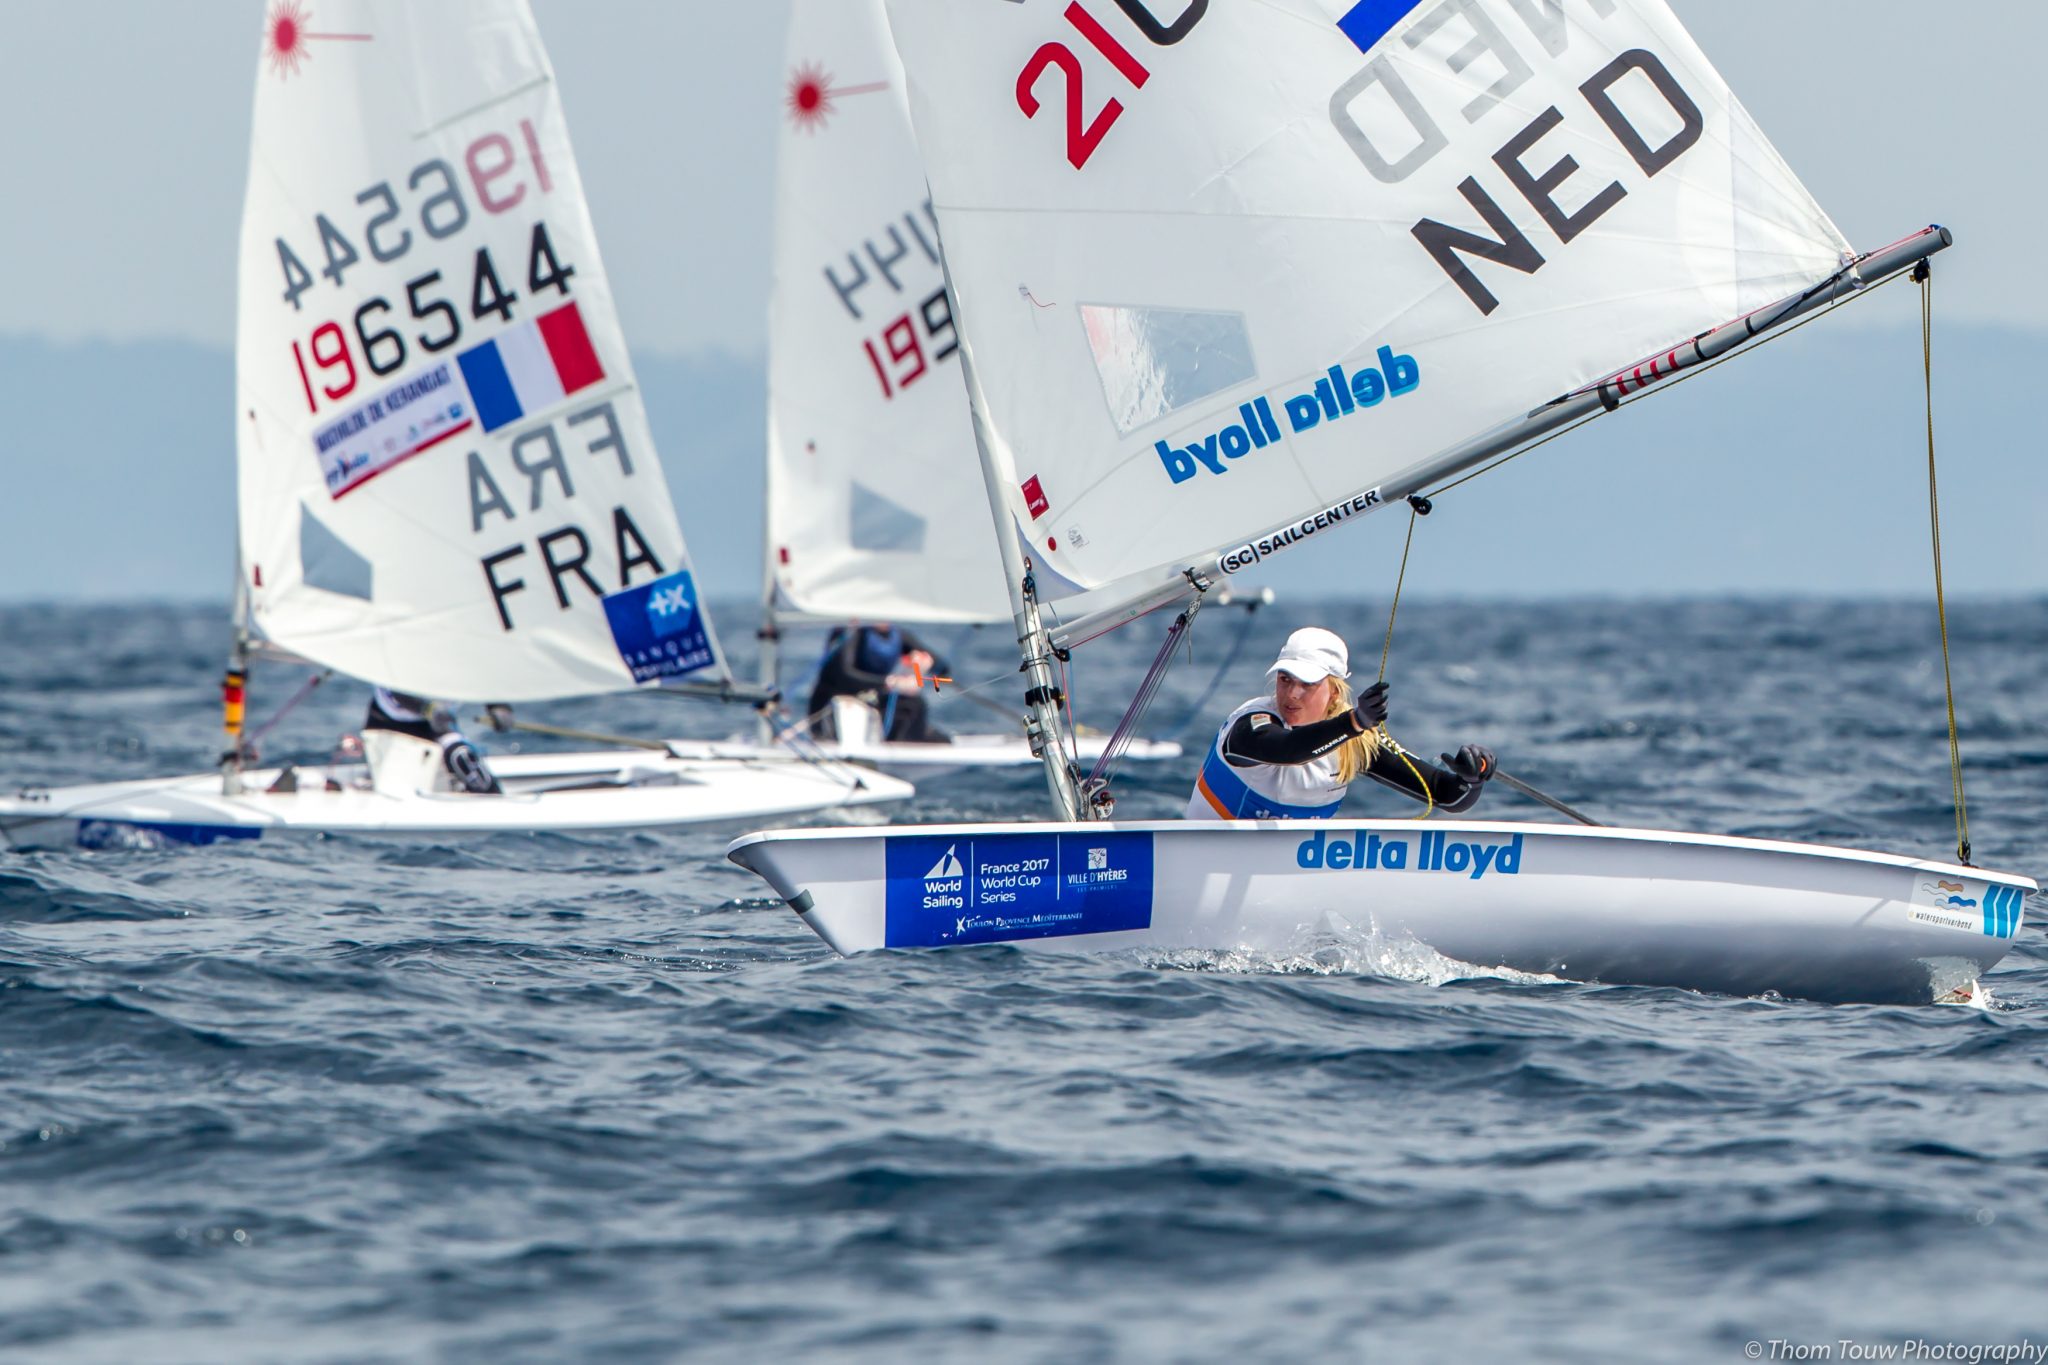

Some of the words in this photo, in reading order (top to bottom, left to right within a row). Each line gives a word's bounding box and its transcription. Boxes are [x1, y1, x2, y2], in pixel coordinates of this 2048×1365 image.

[1411, 48, 1703, 316] NED
[291, 222, 576, 414] 196544
[481, 506, 664, 632] FRA
[1312, 734, 1348, 755] TITANIUM
[1296, 830, 1408, 869] delta
[1418, 830, 1523, 880] lloyd
[981, 862, 1020, 875] France
[1022, 859, 1049, 872] 2017
[981, 876, 1015, 889] World
[1017, 875, 1041, 888] Cup
[1067, 872, 1088, 884] VILLE
[925, 880, 962, 893] World
[923, 896, 963, 908] Sailing
[981, 891, 1016, 904] Series
